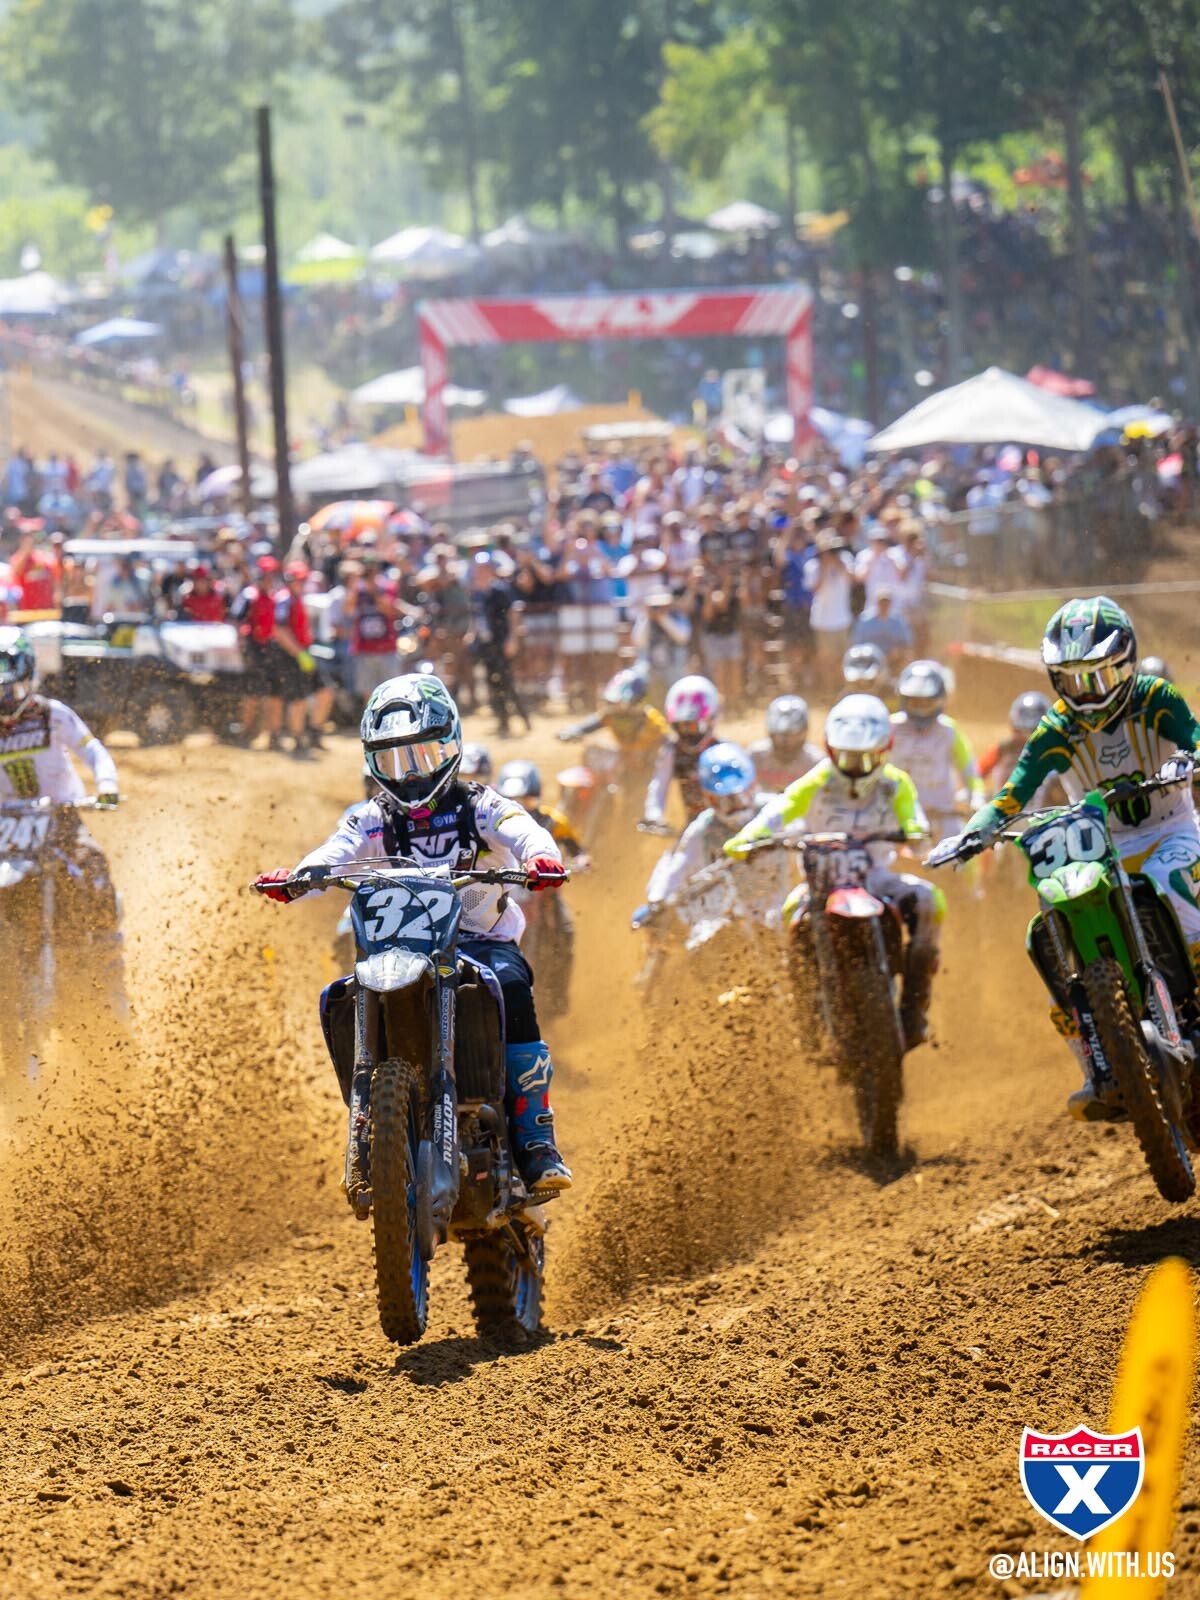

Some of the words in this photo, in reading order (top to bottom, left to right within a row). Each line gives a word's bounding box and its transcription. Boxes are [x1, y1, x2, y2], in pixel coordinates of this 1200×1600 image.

[1029, 818, 1109, 880] 30
[363, 886, 454, 942] 32
[442, 1093, 453, 1165] DUNLOP
